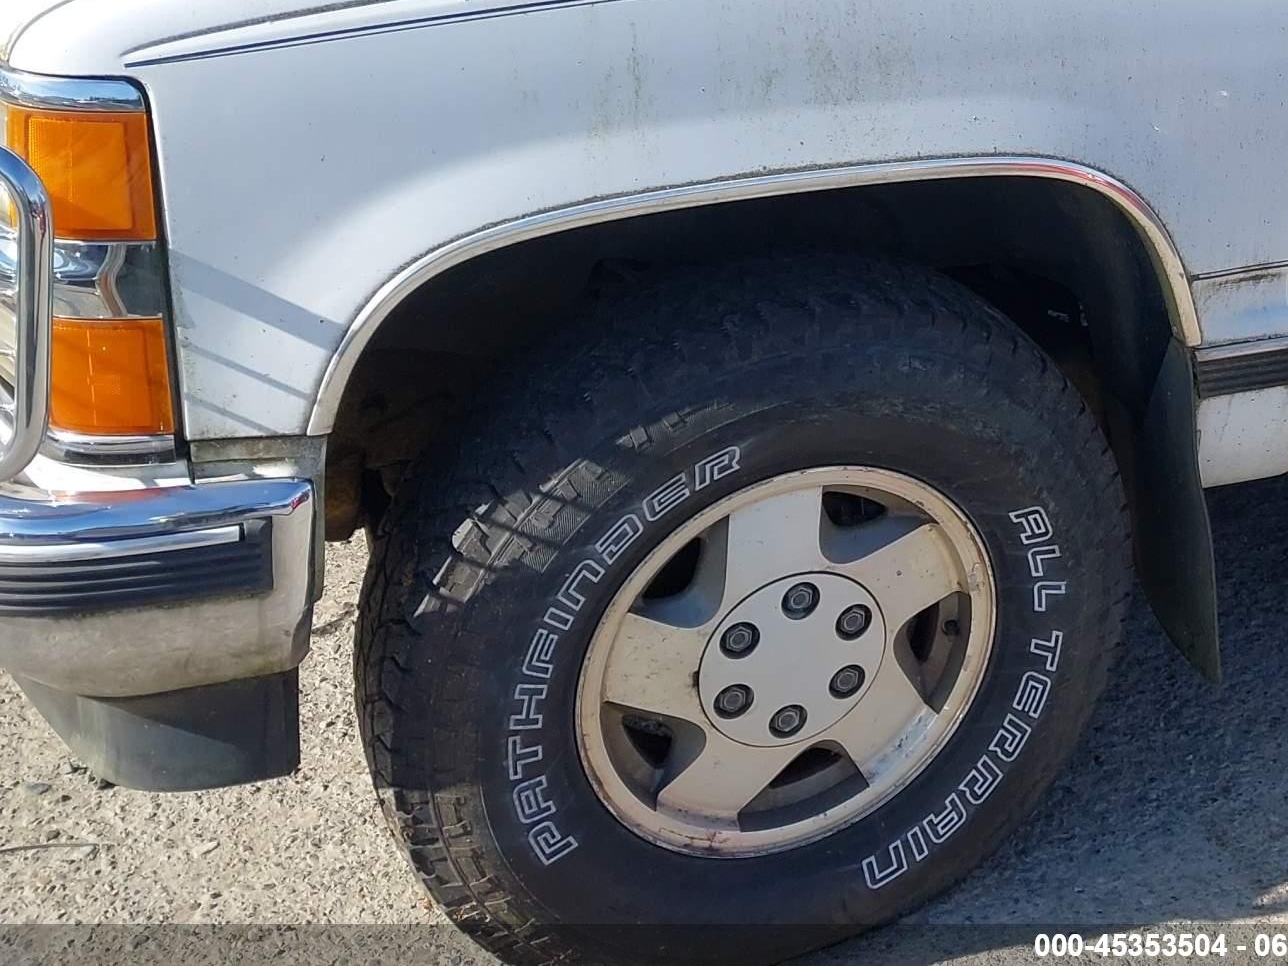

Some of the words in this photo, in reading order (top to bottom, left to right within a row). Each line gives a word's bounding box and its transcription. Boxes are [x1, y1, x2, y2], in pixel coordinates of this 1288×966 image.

[507, 446, 741, 867] PATHFINDER
[1008, 506, 1068, 613] ALL
[861, 631, 1064, 890] TERRAIN
